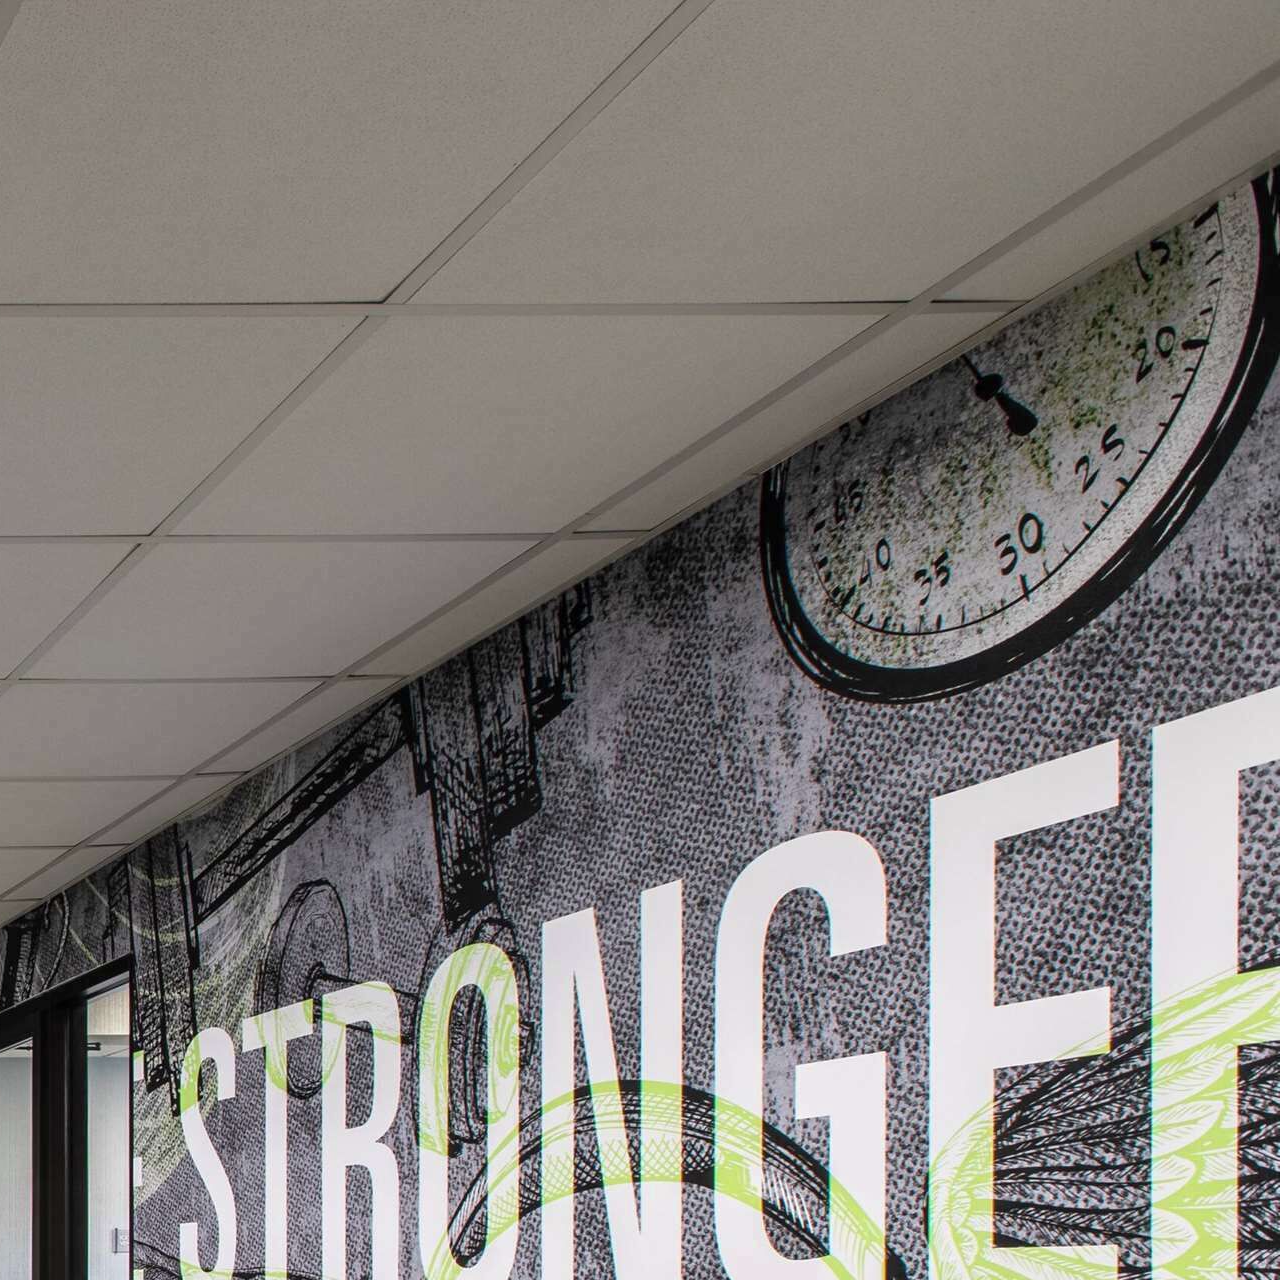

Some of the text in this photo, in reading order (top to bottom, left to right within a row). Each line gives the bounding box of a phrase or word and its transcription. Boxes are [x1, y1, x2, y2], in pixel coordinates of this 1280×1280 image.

[1136, 326, 1176, 383] 20
[1075, 423, 1125, 494] 25
[994, 513, 1043, 576] 30
[914, 551, 951, 606] 35
